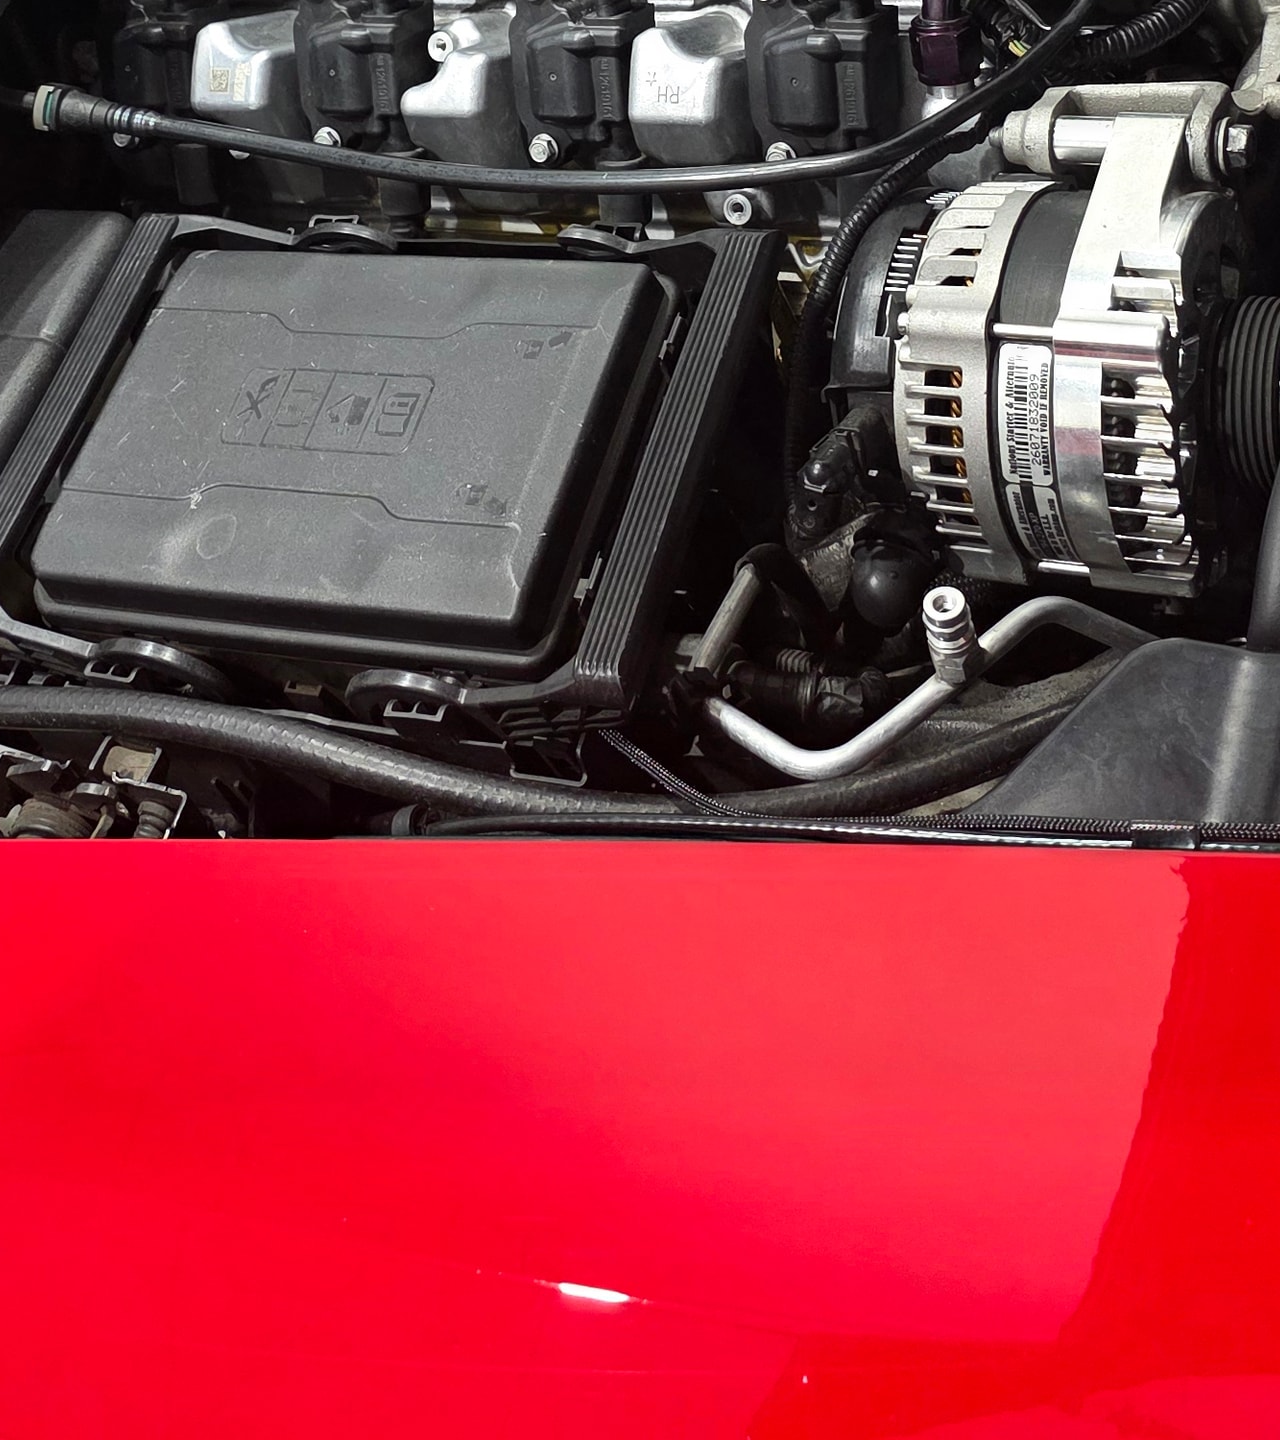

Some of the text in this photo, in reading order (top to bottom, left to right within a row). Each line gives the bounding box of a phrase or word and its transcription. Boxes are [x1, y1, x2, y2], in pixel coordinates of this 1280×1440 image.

[657, 84, 681, 105] RH
[1005, 354, 1015, 398] Alternato
[1004, 401, 1014, 409] &
[1028, 373, 1041, 466] 26071832009
[1039, 362, 1051, 476] WARRANTY VOID IF REMOVED
[1005, 412, 1015, 442] Starter
